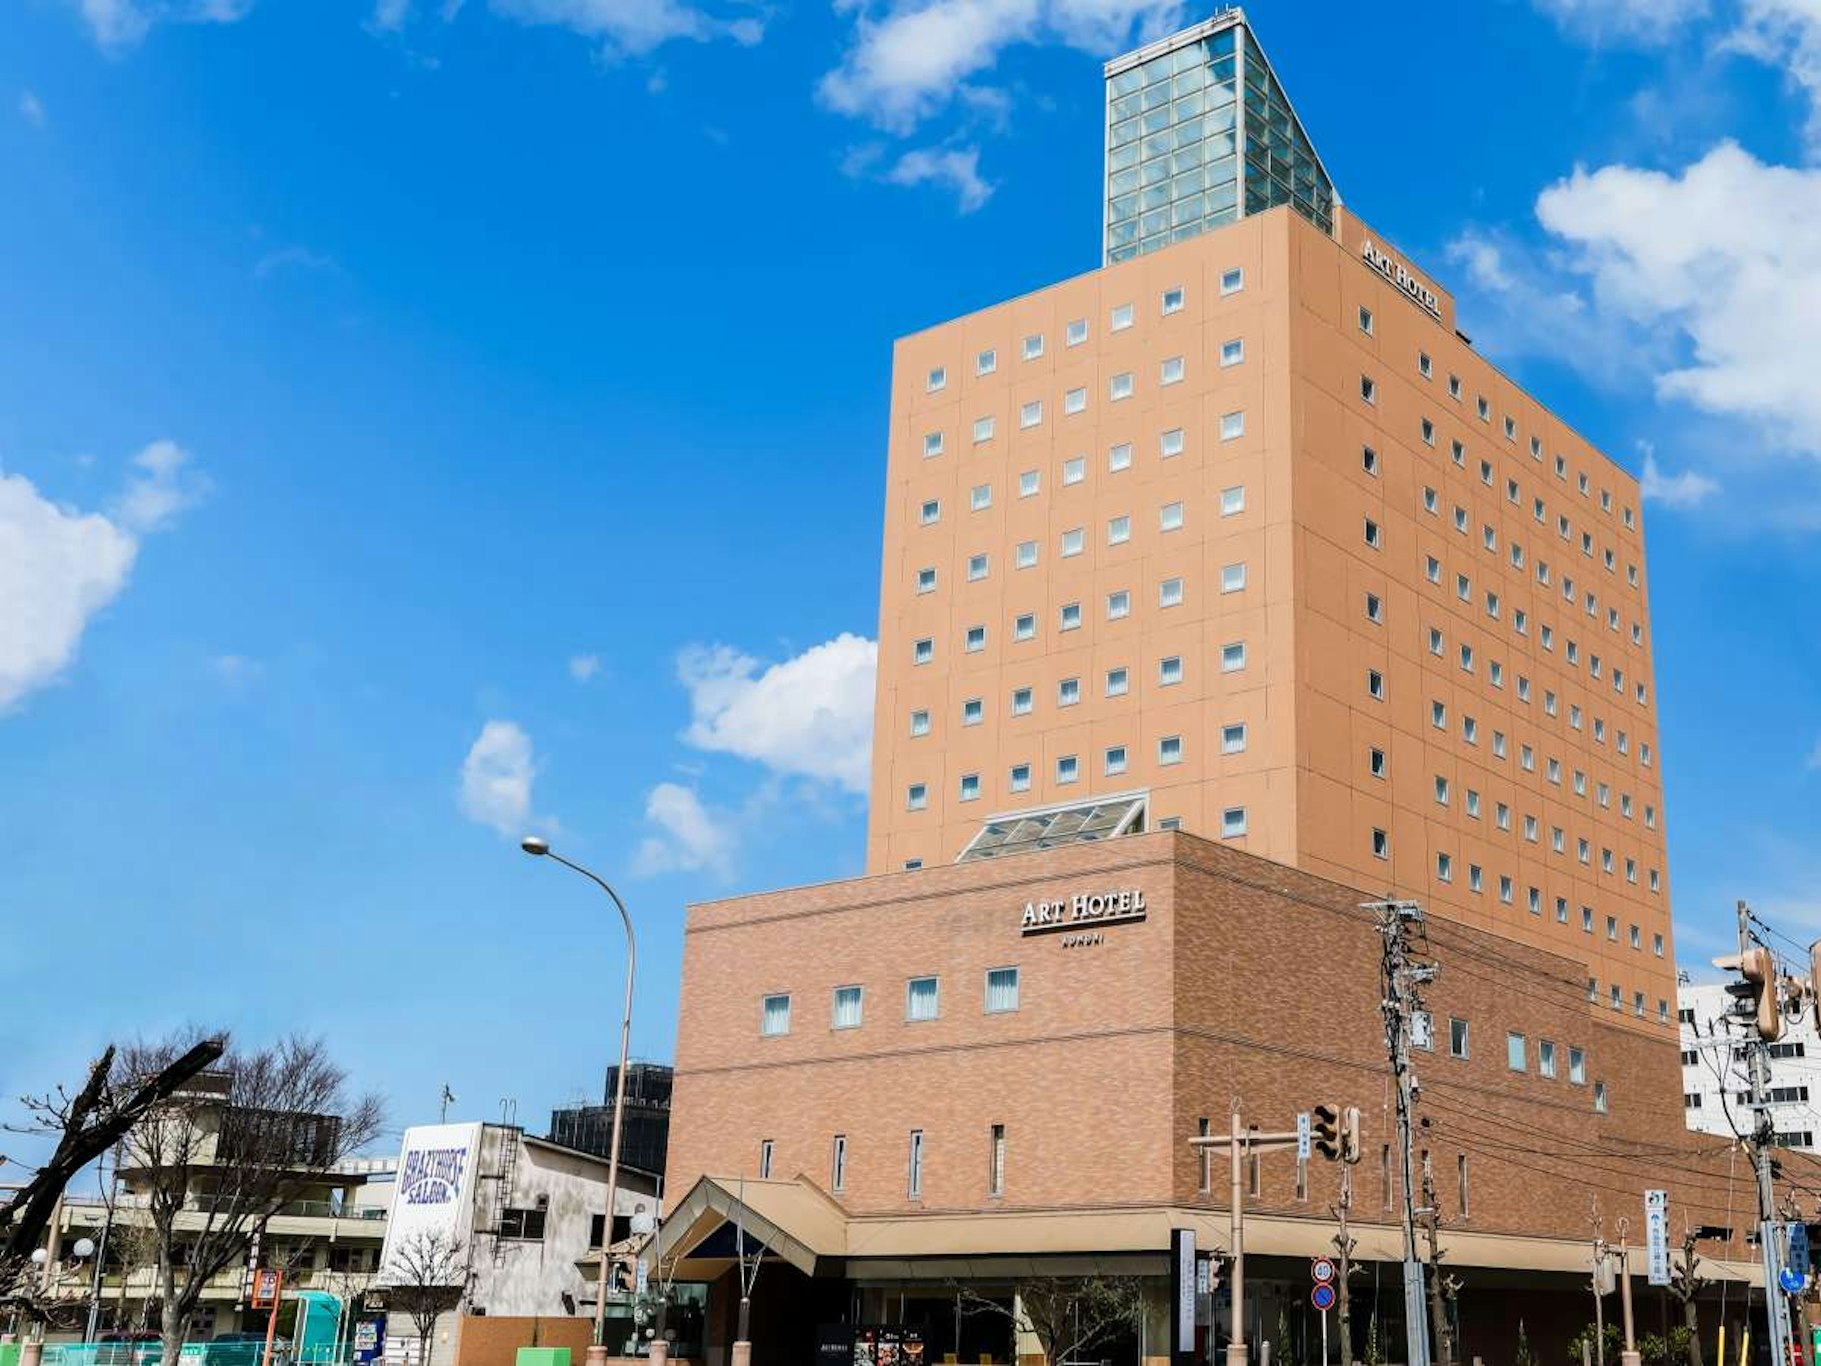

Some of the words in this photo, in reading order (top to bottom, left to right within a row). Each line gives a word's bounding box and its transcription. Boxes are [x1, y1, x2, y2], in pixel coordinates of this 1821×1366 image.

[1363, 239, 1393, 276] ART
[1396, 264, 1442, 316] HOTEL
[1021, 900, 1065, 926] ART
[1071, 890, 1147, 920] HOTEL
